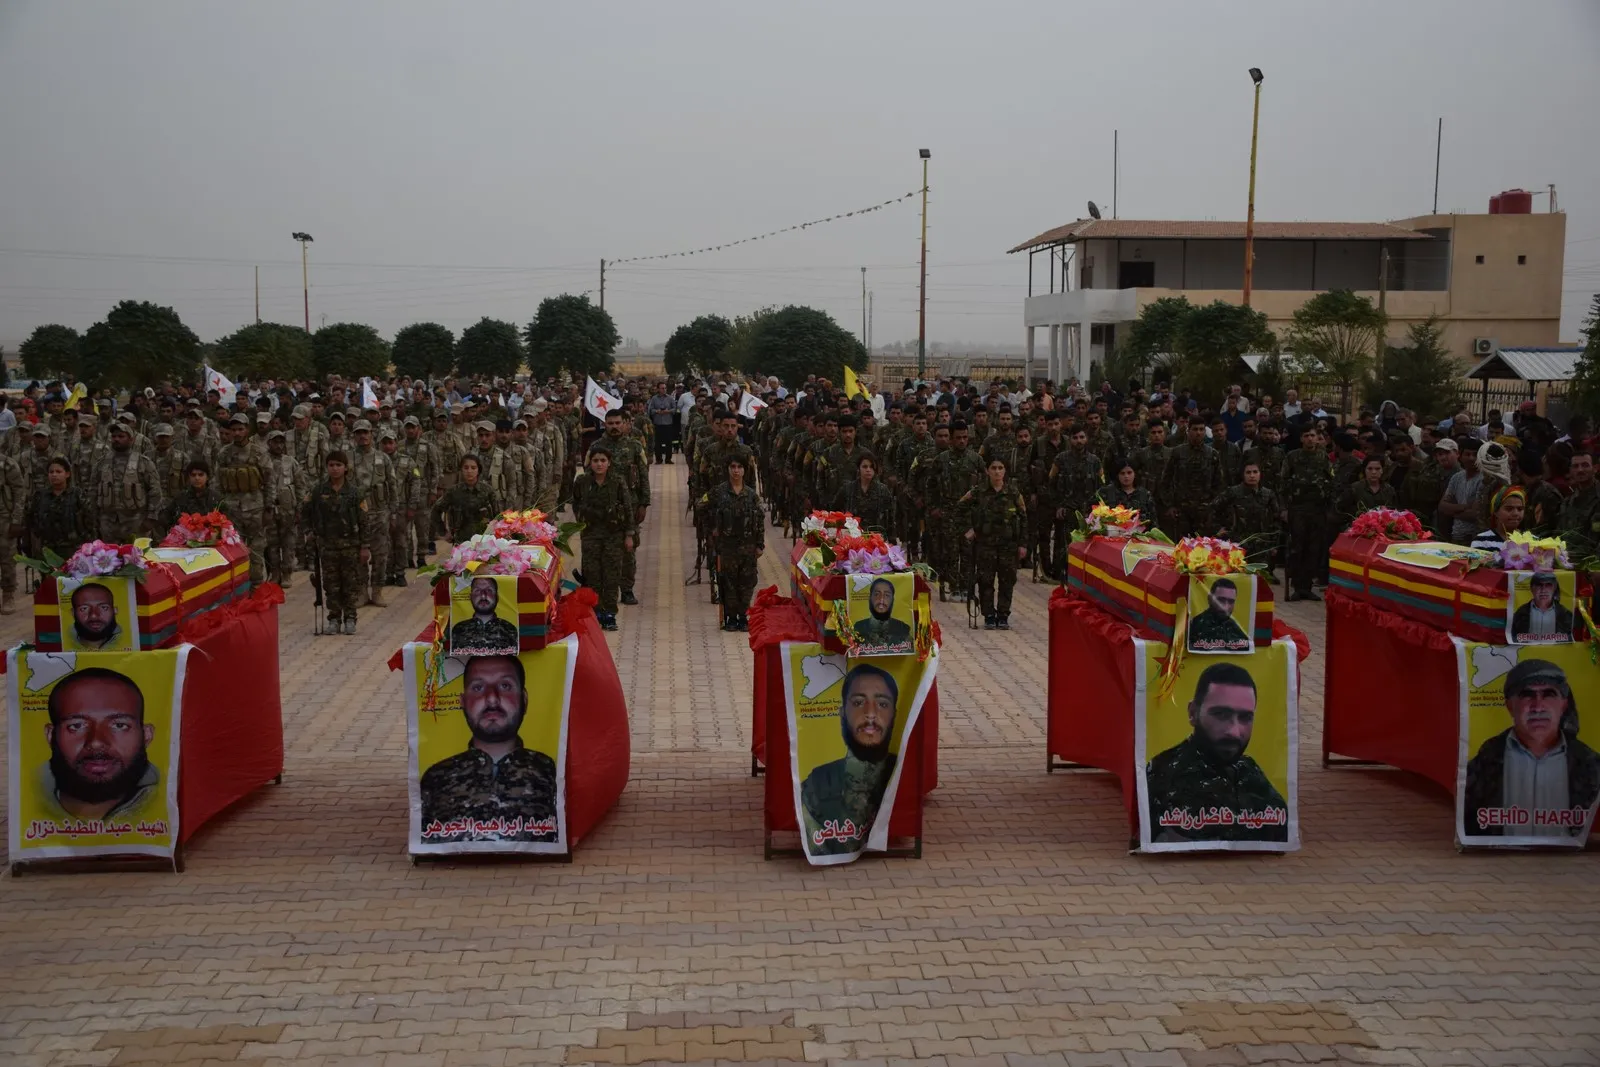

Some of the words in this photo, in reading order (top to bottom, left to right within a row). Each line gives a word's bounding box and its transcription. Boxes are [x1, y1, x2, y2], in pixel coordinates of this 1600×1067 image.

[472, 816, 523, 837] ابراهيم
[1159, 807, 1193, 830] راشد
[1193, 806, 1235, 830] فاضل
[1237, 805, 1286, 829] الشهيد
[1477, 804, 1529, 829] ŞEHÎD
[25, 819, 55, 840] نزال
[105, 820, 133, 838] عبد
[136, 819, 169, 837] الشهيد
[420, 817, 473, 839] الجوهر
[813, 818, 856, 846] فياض
